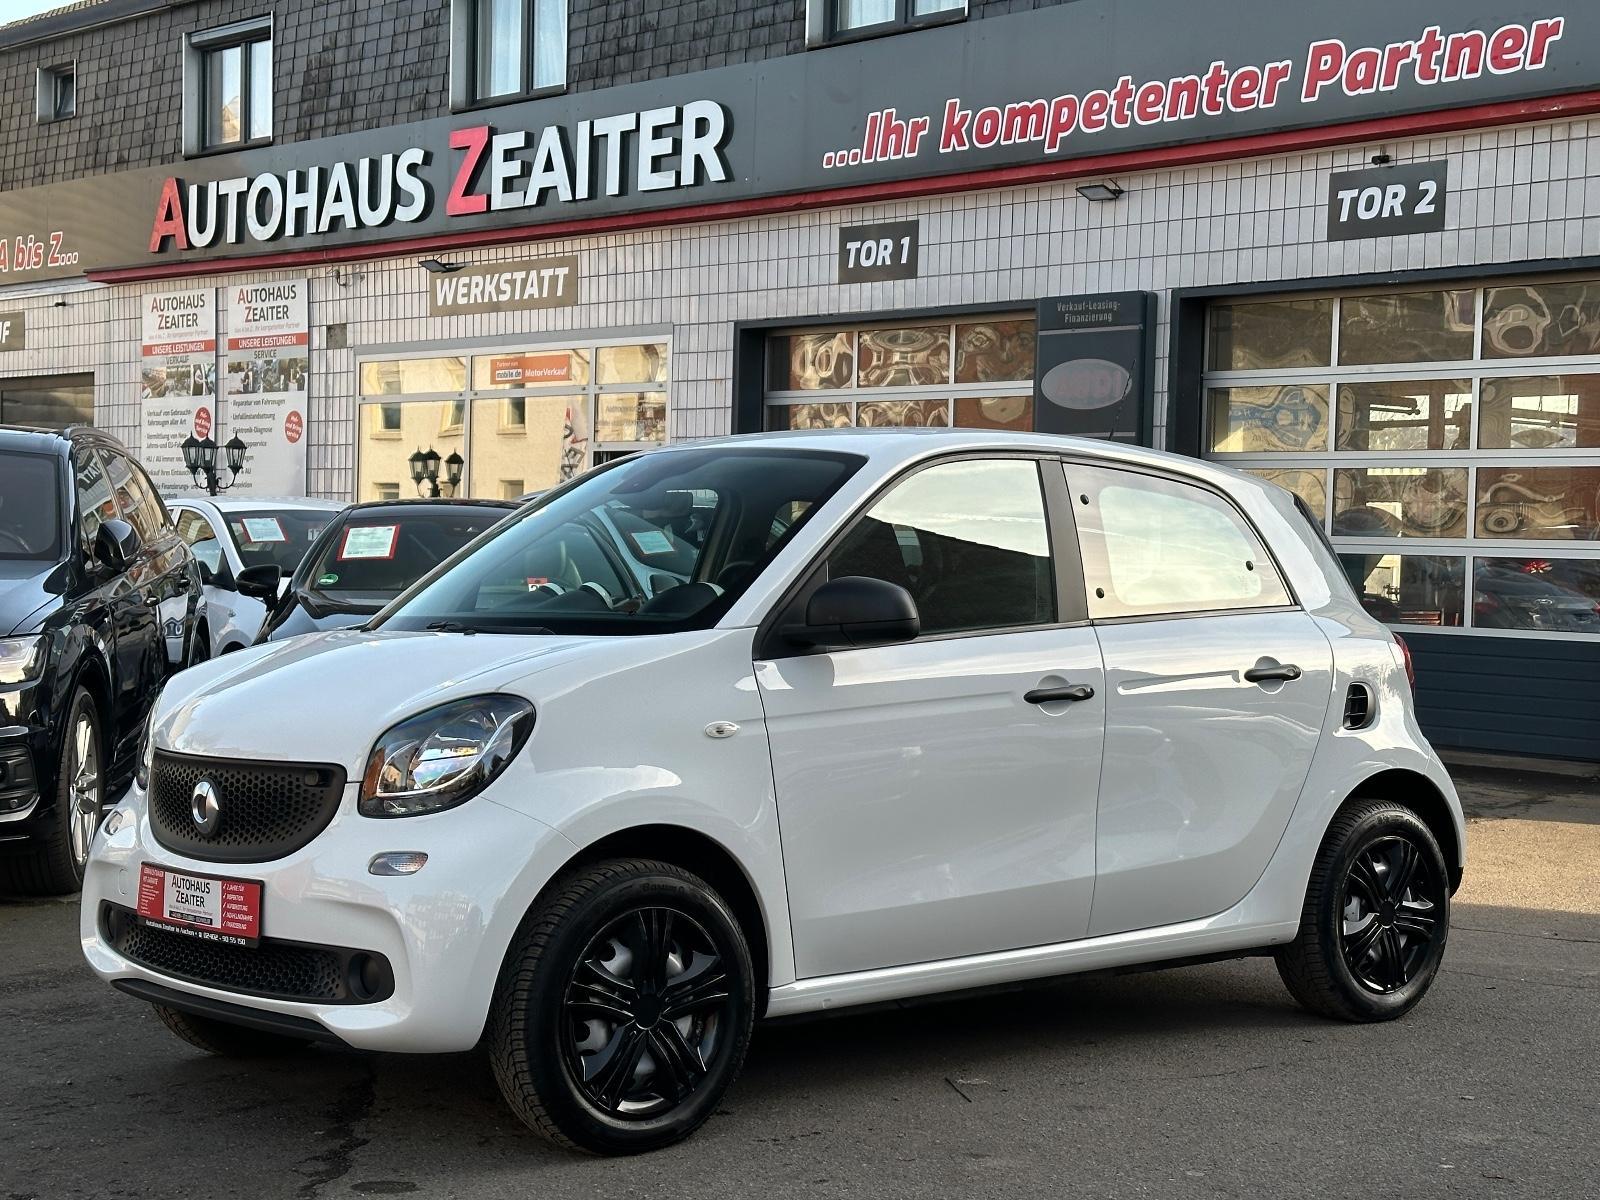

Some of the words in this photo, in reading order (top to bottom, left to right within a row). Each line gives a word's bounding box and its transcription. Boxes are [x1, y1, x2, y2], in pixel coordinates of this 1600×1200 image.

[939, 60, 1292, 153] kompetenter
[1301, 17, 1564, 102] Partner
[150, 148, 425, 253] AUTOHAUS
[446, 100, 726, 216] ZEAITER
[1336, 184, 1405, 222] TOR
[1414, 180, 1437, 214] 2
[13, 234, 44, 271] bis
[846, 239, 891, 268] TOR
[900, 237, 910, 263] 1
[237, 284, 297, 304] AUTOHAUS
[436, 266, 570, 306] WERKSTATT
[151, 293, 206, 313] AUTOHAUS
[158, 312, 198, 329] ZEAITER
[244, 305, 289, 323] ZEAITER
[1064, 312, 1113, 323] Finanzierung
[152, 344, 172, 355] UNSERE
[172, 341, 205, 353] LEISTUNGEN
[238, 337, 260, 348] UNSERE
[261, 335, 297, 347] LEISTUNGEN
[165, 355, 190, 365] VERKAUF
[254, 349, 277, 359] SERVICE
[525, 367, 567, 377] MotorVerkauf
[171, 875, 211, 894] AUTOHAUS
[176, 890, 205, 908] ZEAITER
